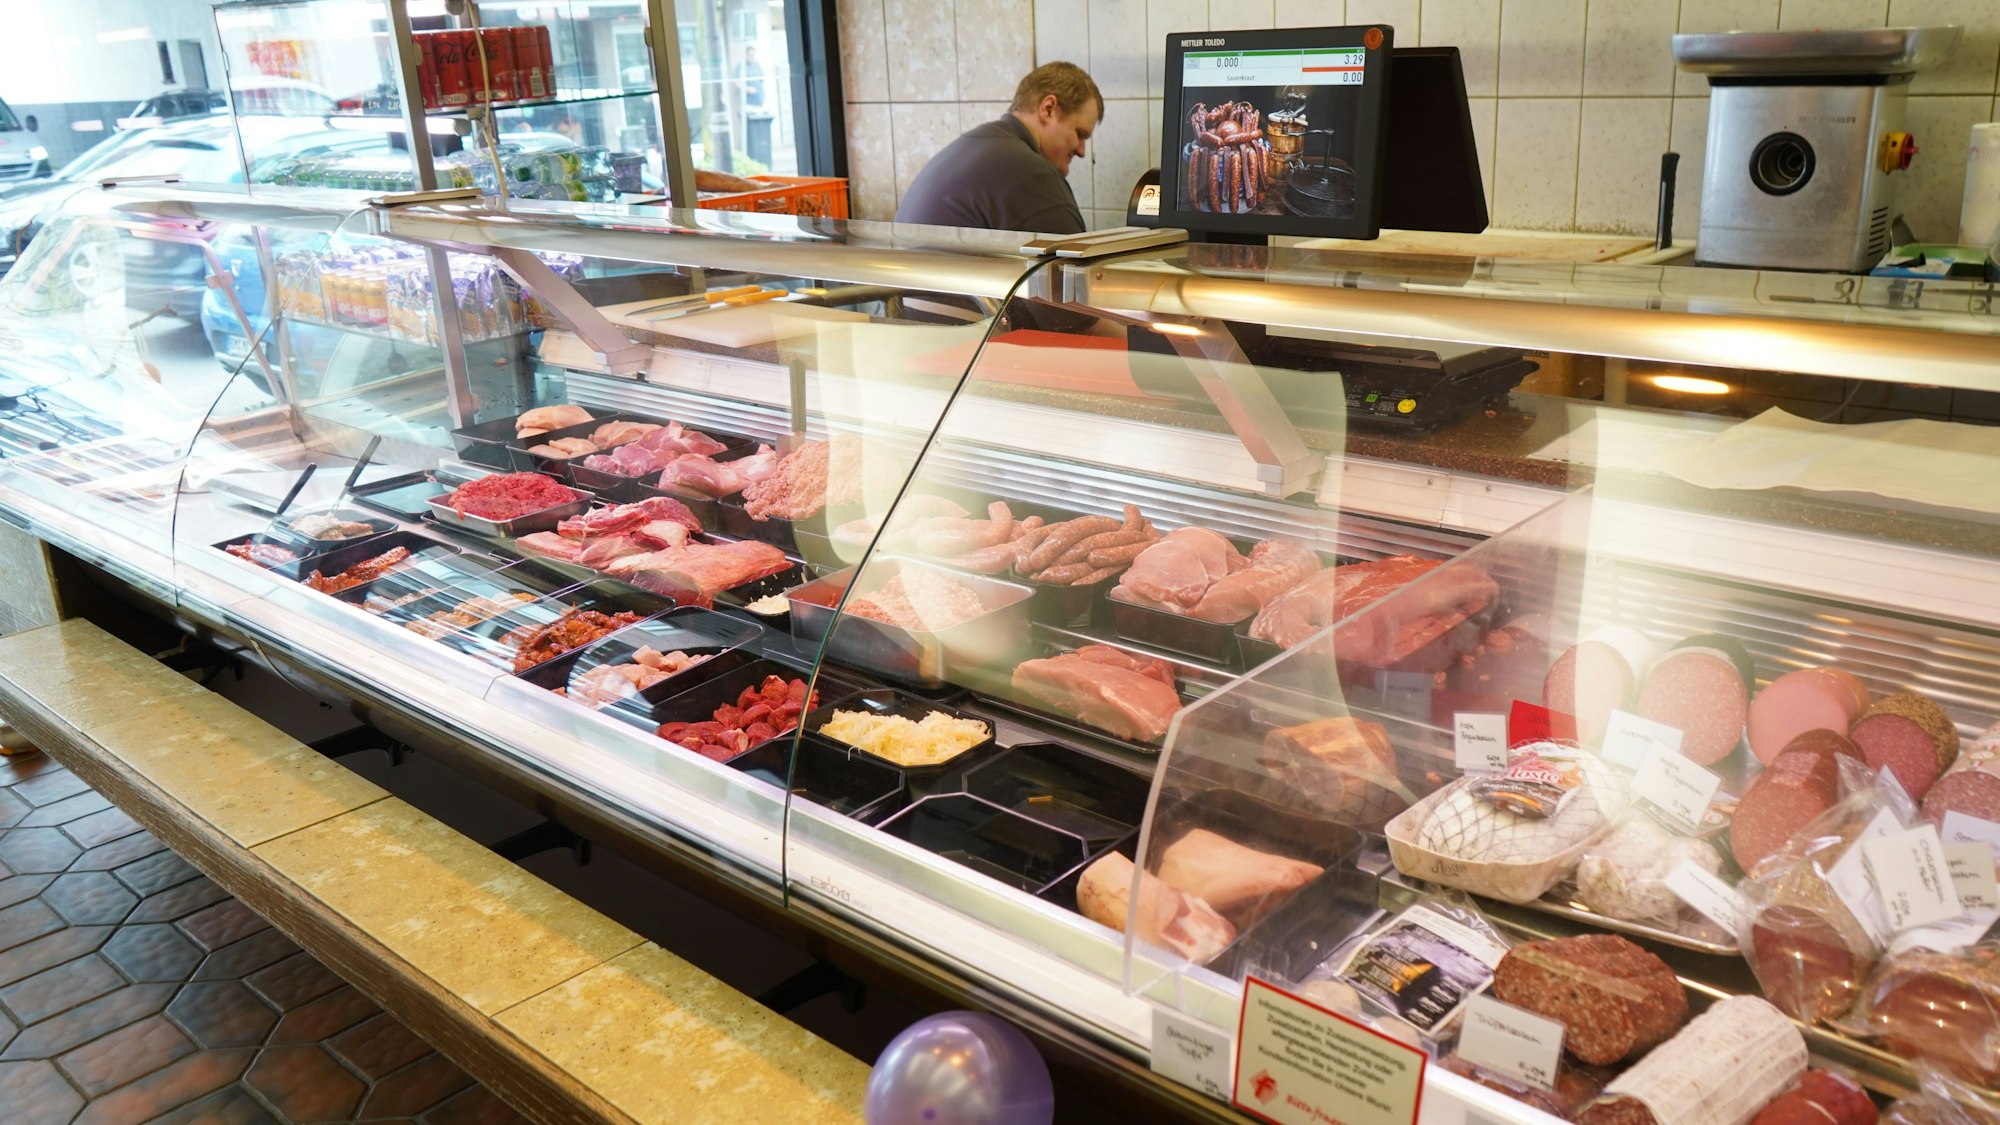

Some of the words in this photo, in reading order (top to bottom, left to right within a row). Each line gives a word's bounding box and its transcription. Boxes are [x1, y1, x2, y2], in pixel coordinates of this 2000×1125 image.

[1181, 39, 1203, 47] METTLER
[1205, 38, 1225, 47] TOLEDO
[1217, 57, 1239, 68] 0.000
[1344, 54, 1364, 65] 3.29
[1226, 74, 1256, 82] Sauerkraut
[1342, 72, 1362, 83] 0.00
[1258, 998, 1312, 1026] Informationen
[1314, 1023, 1324, 1033] zu
[1285, 1045, 1310, 1062] finden
[1312, 1057, 1325, 1070] Sie
[1326, 1065, 1335, 1074] in
[1335, 1069, 1367, 1090] unserer
[1325, 1040, 1372, 1068] Herstellung
[1374, 1062, 1394, 1076] oder
[1258, 1044, 1333, 1085] Kundeninformation
[1334, 1079, 1364, 1100] Unsere
[1352, 1062, 1386, 1085] Zutaten
[1286, 1093, 1313, 1114] Bitte
